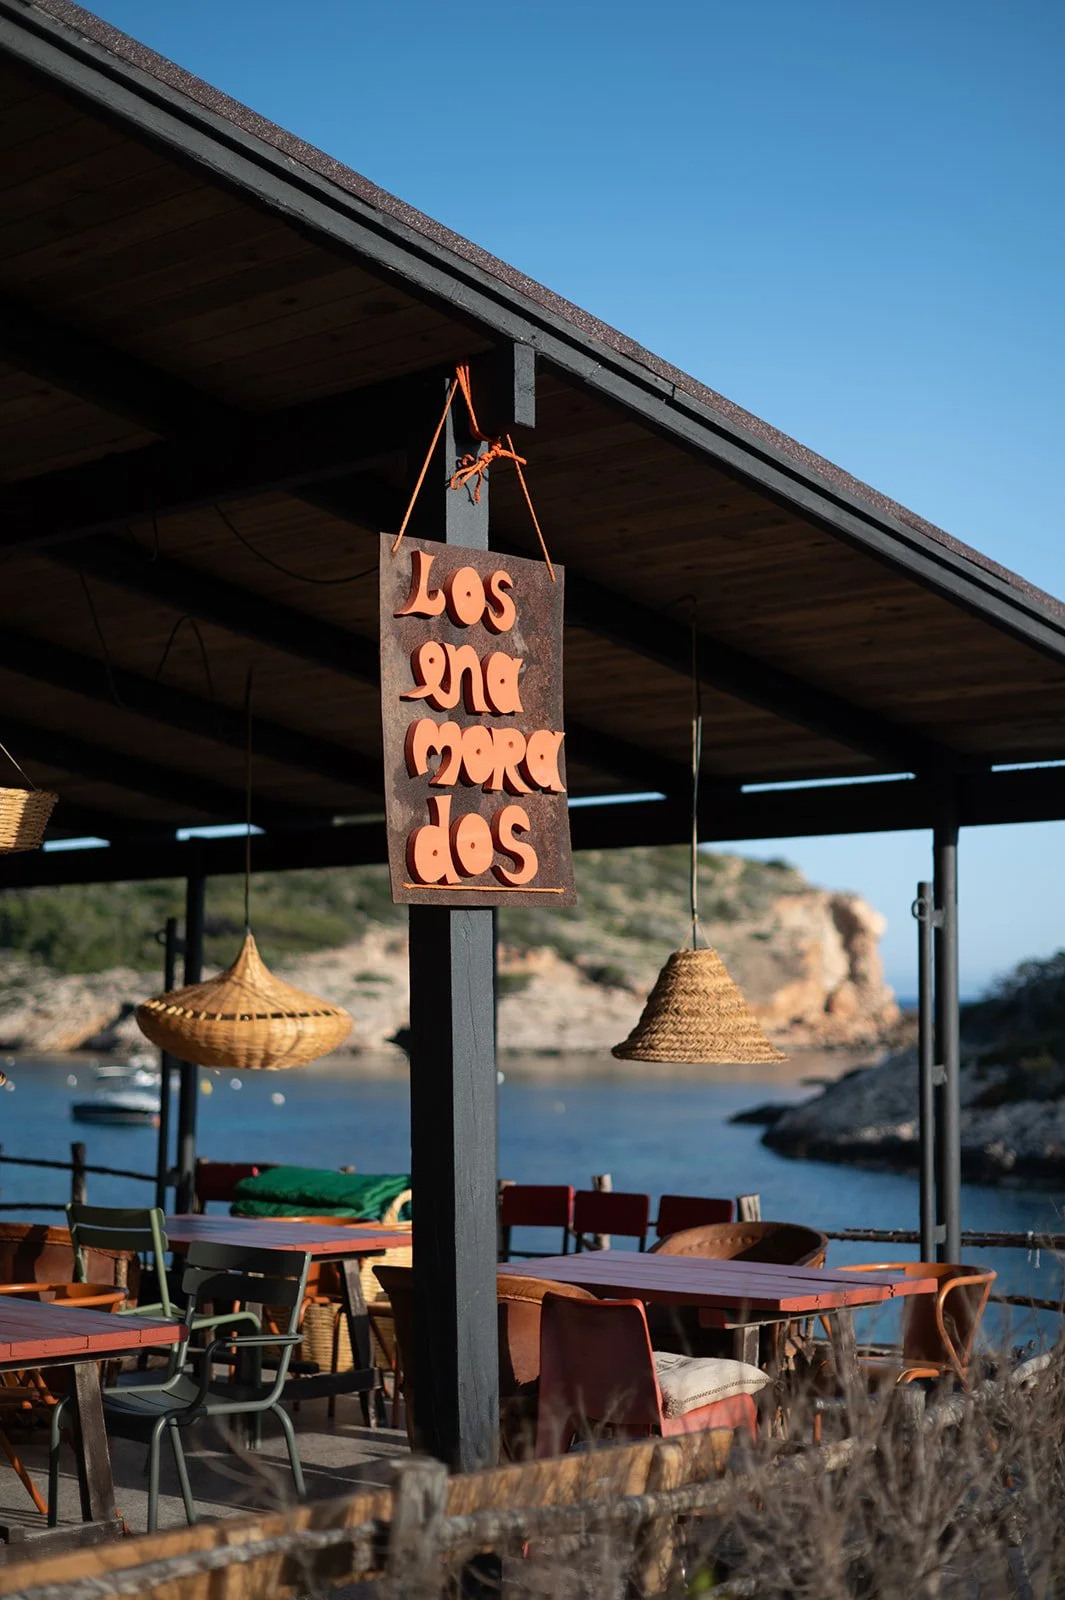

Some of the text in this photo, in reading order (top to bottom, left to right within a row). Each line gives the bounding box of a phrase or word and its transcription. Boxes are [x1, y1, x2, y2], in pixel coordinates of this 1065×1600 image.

[395, 550, 516, 633] Los
[401, 640, 524, 713] ena
[407, 795, 539, 885] dos
